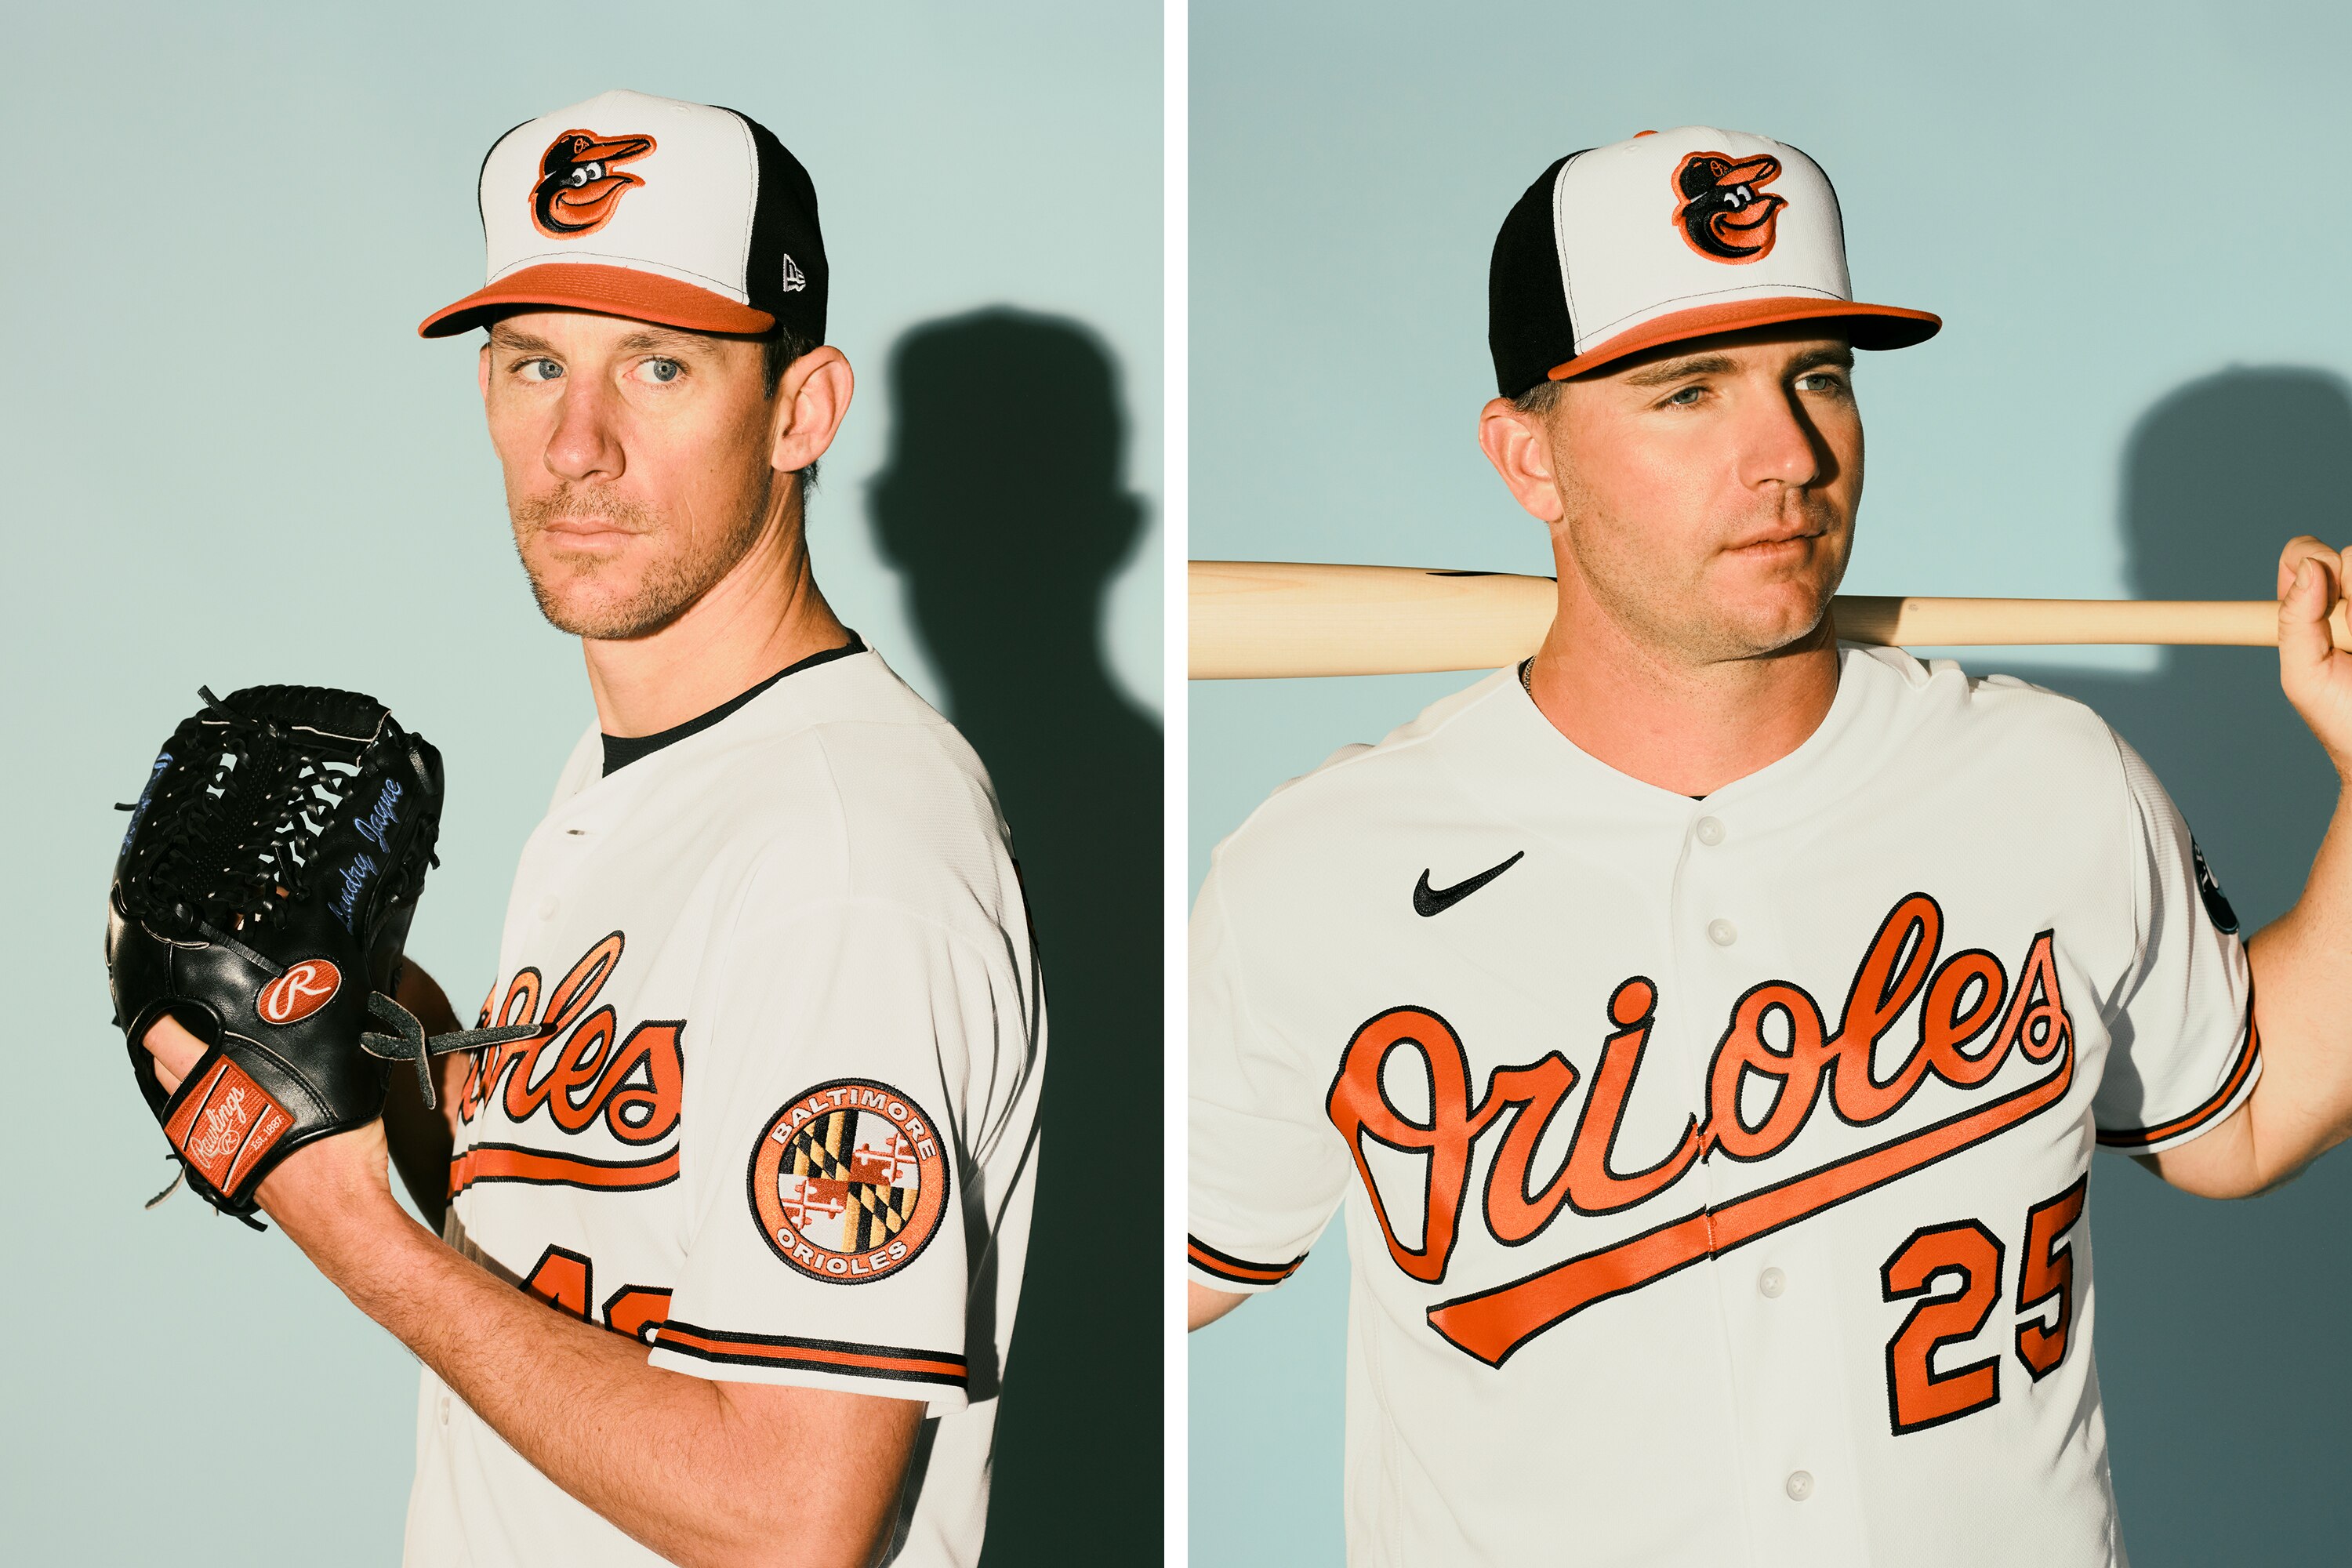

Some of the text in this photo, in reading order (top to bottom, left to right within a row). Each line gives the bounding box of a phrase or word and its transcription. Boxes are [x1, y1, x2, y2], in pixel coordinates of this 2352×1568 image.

[354, 778, 403, 853] Jayne
[456, 930, 687, 1146] oles
[263, 1115, 282, 1136] 1887
[771, 1088, 936, 1160] BALTIMORE
[1326, 892, 2074, 1284] Orioles
[190, 1087, 247, 1169] Rawlings
[777, 1228, 908, 1275] ORIOLES
[1879, 1171, 2088, 1436] 25
